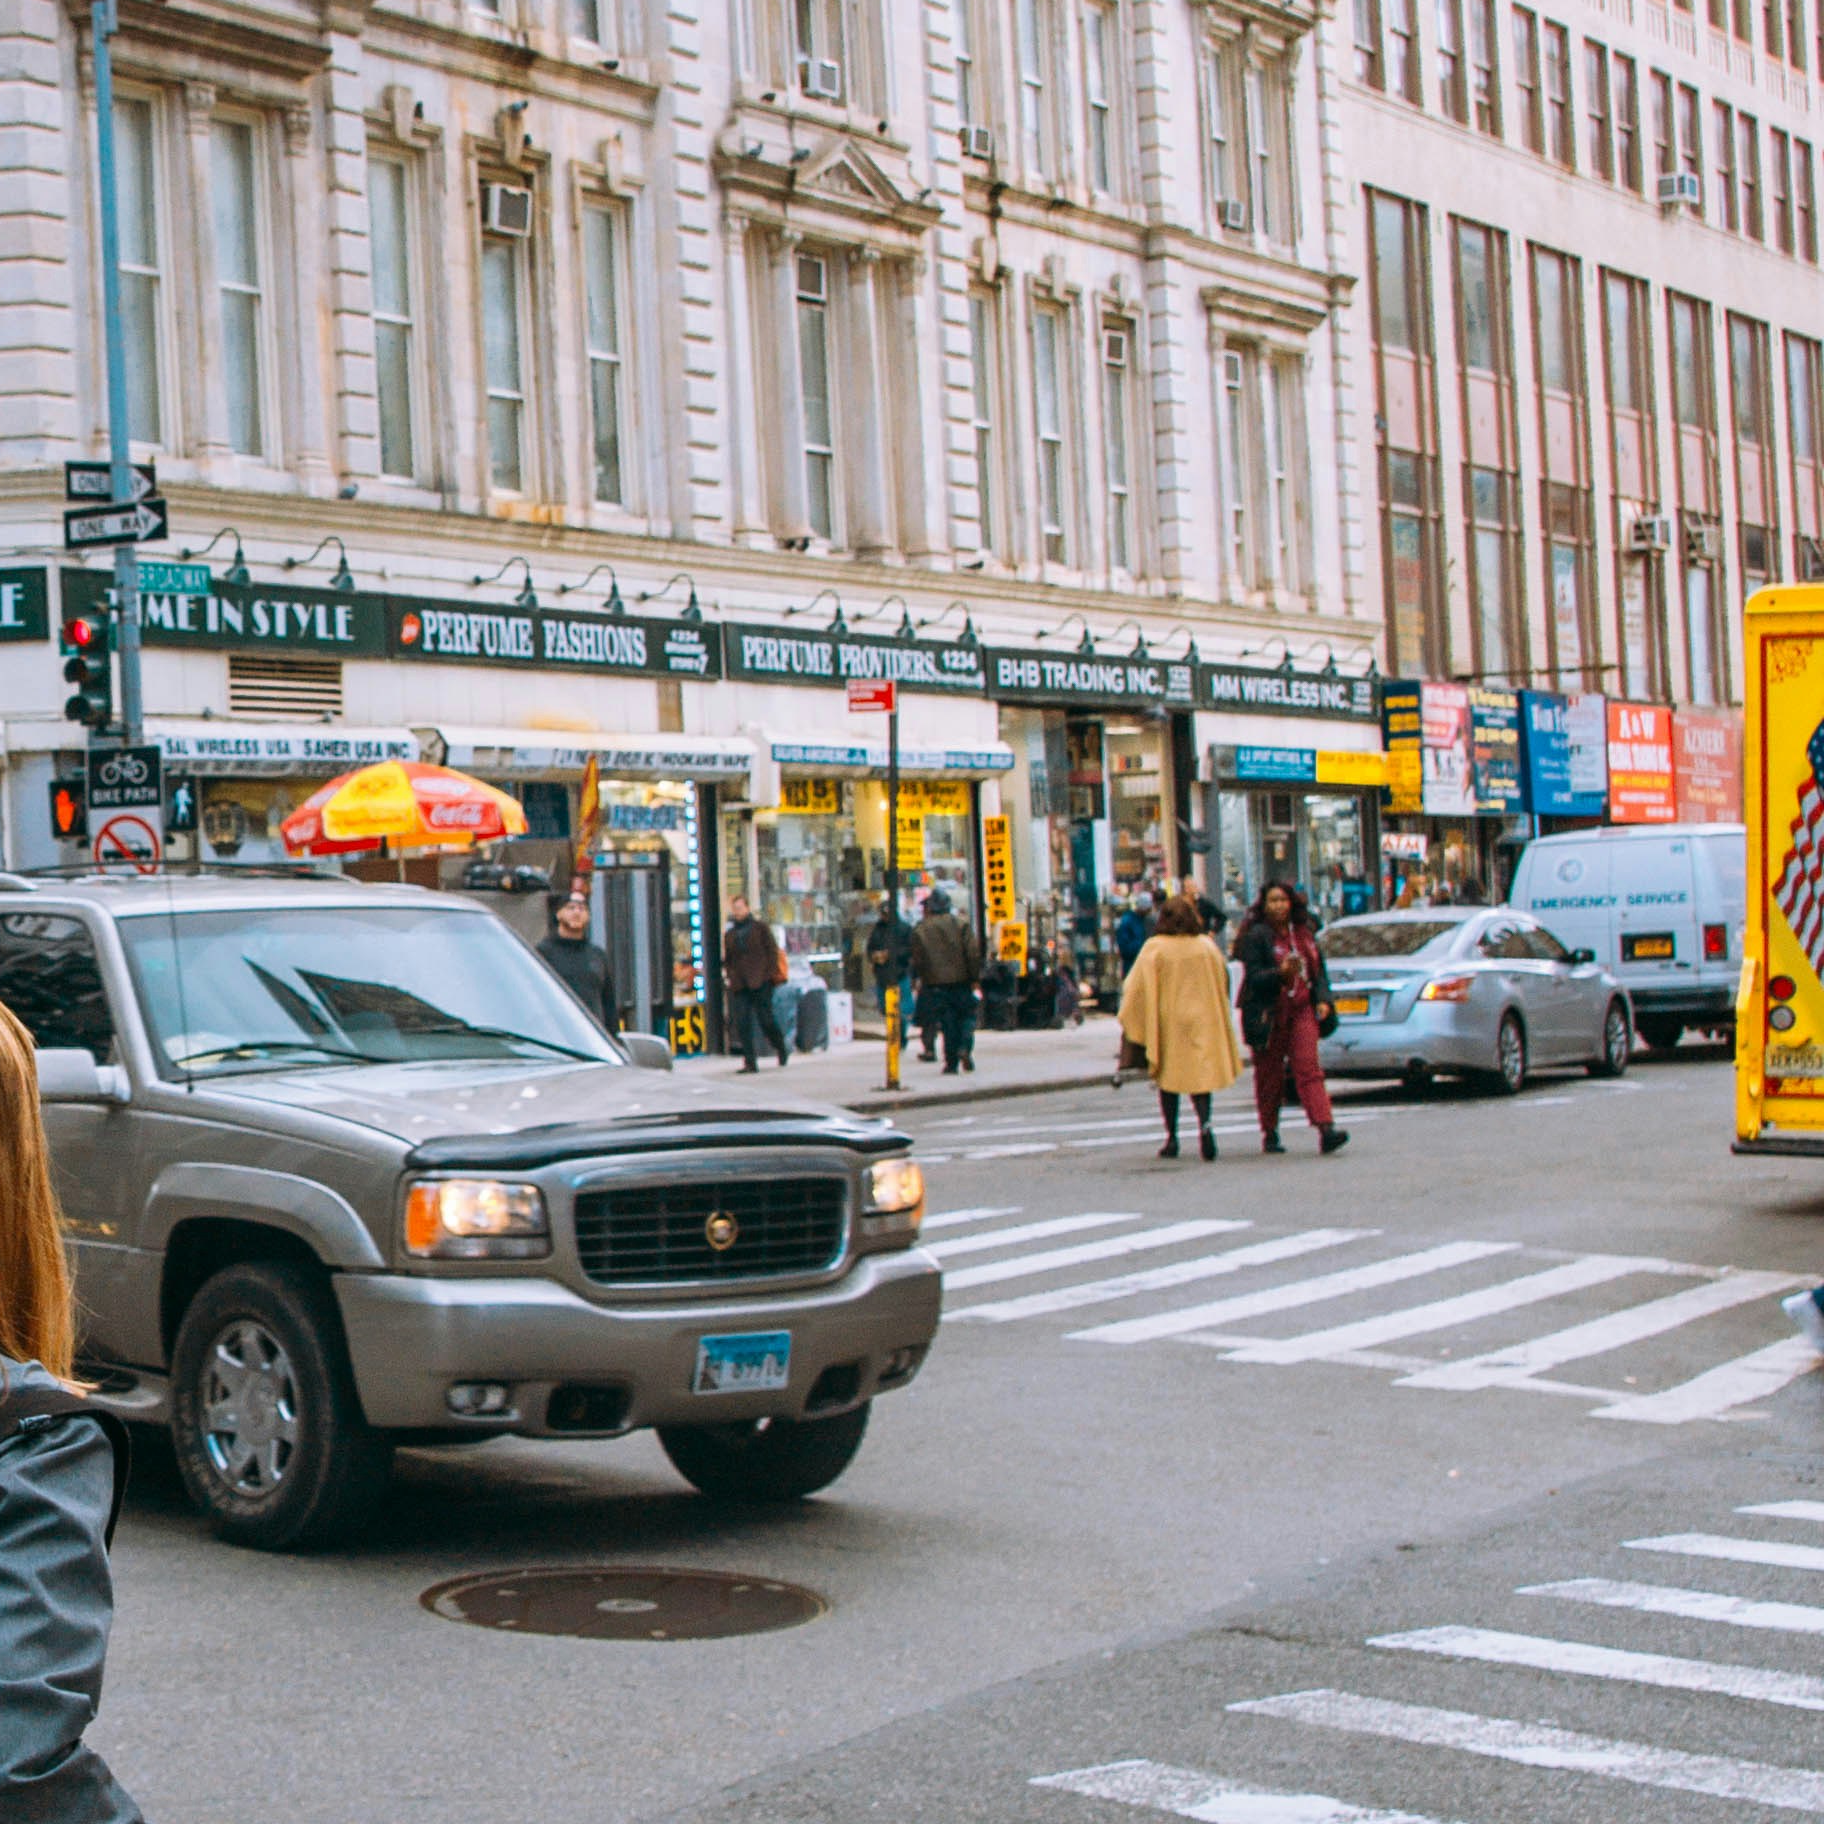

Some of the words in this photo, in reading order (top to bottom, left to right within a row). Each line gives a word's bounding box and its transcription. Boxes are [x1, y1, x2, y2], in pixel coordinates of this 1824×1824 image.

[78, 519, 104, 538] ONE
[121, 513, 151, 530] WAY
[205, 596, 244, 635] IN
[251, 600, 356, 642] STYLE
[421, 609, 534, 658] PERFUME
[543, 619, 647, 667] FASHIONS
[741, 635, 833, 676] PERFUME
[838, 643, 936, 683] PROVIDERS
[942, 649, 978, 671] 1234
[997, 658, 1041, 687] BHB
[1041, 660, 1125, 694] TRADING
[1127, 665, 1164, 695] INC.
[1211, 674, 1240, 700] MM
[1240, 676, 1320, 708] WIRELESS
[1320, 683, 1352, 709] INC.
[165, 738, 189, 755] SAL
[195, 738, 259, 755] WIRELESS
[266, 739, 291, 755] USA
[304, 739, 351, 758] SAHER
[355, 741, 382, 759] USA
[92, 787, 120, 804] BIKE
[124, 785, 158, 802] PATH
[1381, 833, 1419, 851] ATM
[1531, 895, 1617, 910] EMERGENCY
[1626, 891, 1688, 905] SERVICE
